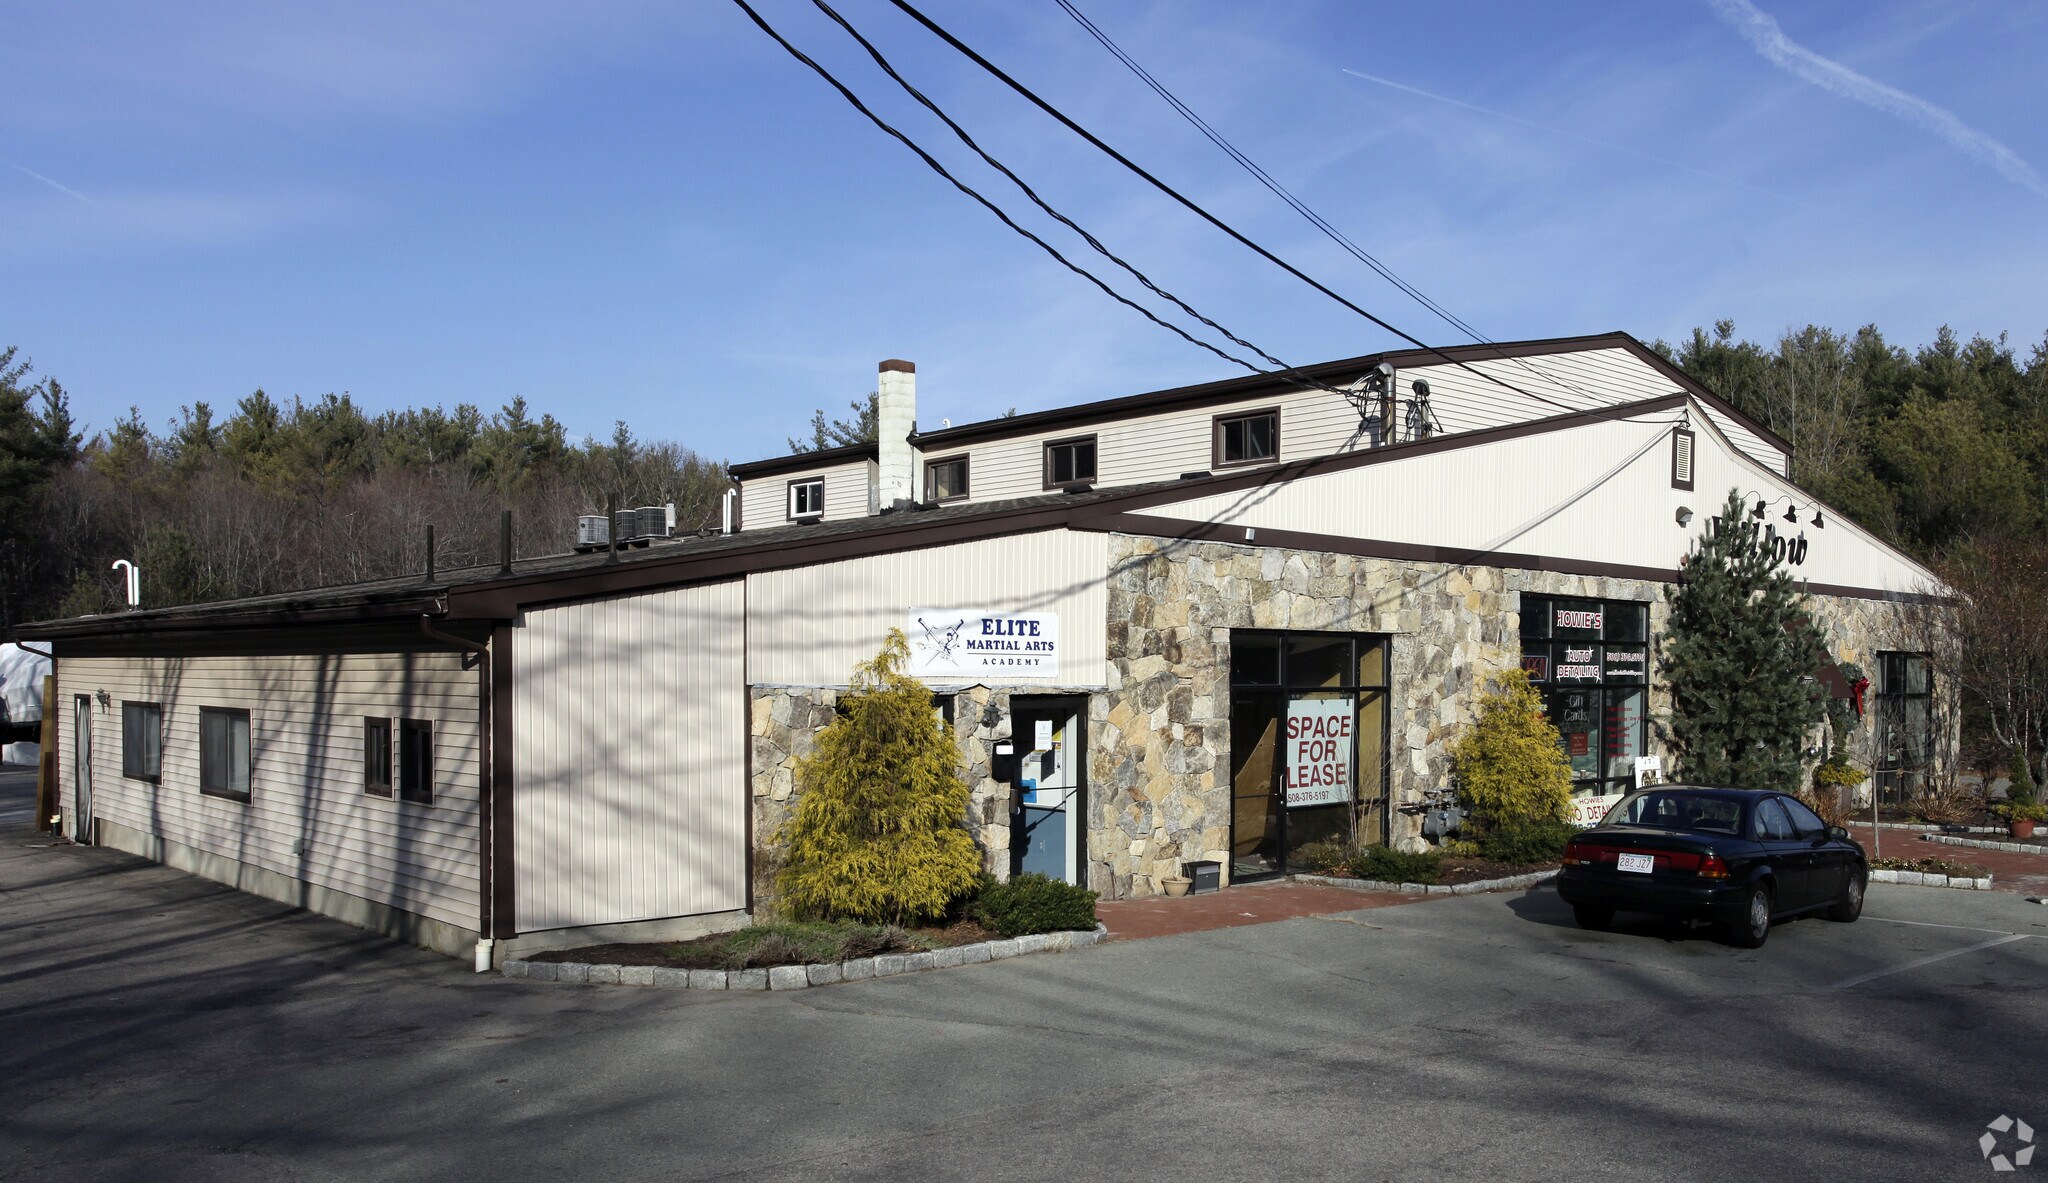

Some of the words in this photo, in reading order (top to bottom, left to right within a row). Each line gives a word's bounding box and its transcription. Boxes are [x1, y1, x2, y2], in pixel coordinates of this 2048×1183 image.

[1556, 610, 1603, 629] HOWIE'S
[981, 618, 1041, 637] ELITE
[966, 639, 1021, 651] MARTIAL
[1025, 641, 1054, 651] ARTS
[1566, 649, 1592, 663] AUTO
[1557, 664, 1600, 679] DETAILING
[1287, 715, 1351, 739] SPACE
[1298, 739, 1337, 763] FOR
[1286, 763, 1347, 788] LEASE
[1287, 790, 1330, 803] 508-376-5197
[1579, 797, 1604, 805] HOWIES
[1619, 857, 1635, 867] 282
[1636, 859, 1652, 869] JZ7
